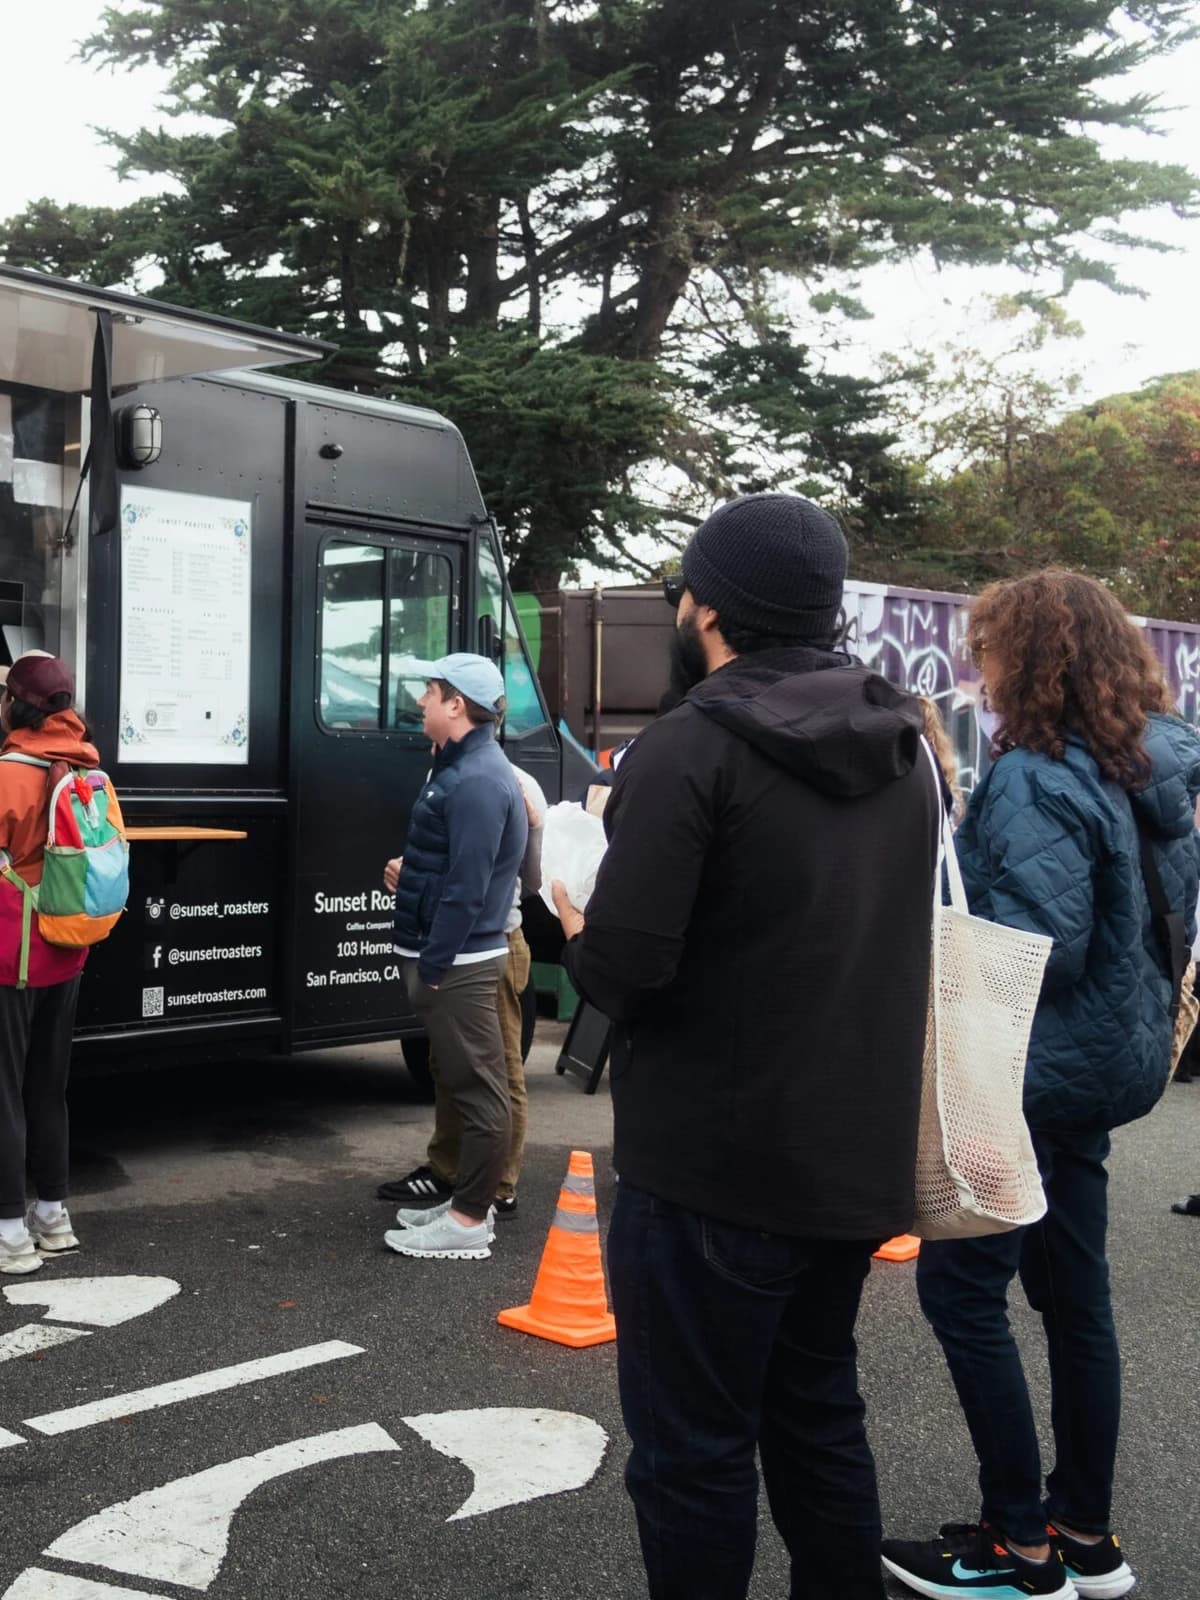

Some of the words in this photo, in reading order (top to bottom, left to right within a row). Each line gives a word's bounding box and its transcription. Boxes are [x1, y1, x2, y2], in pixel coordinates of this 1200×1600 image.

[169, 900, 269, 920] @sunset_roasters
[314, 891, 368, 914] Sunset
[168, 943, 262, 965] @sunsetroasters
[337, 941, 358, 957] 103
[306, 971, 327, 987] San
[329, 967, 382, 986] Francisco,
[383, 965, 400, 981] CA
[167, 987, 267, 1007] sunsetroasters.com
